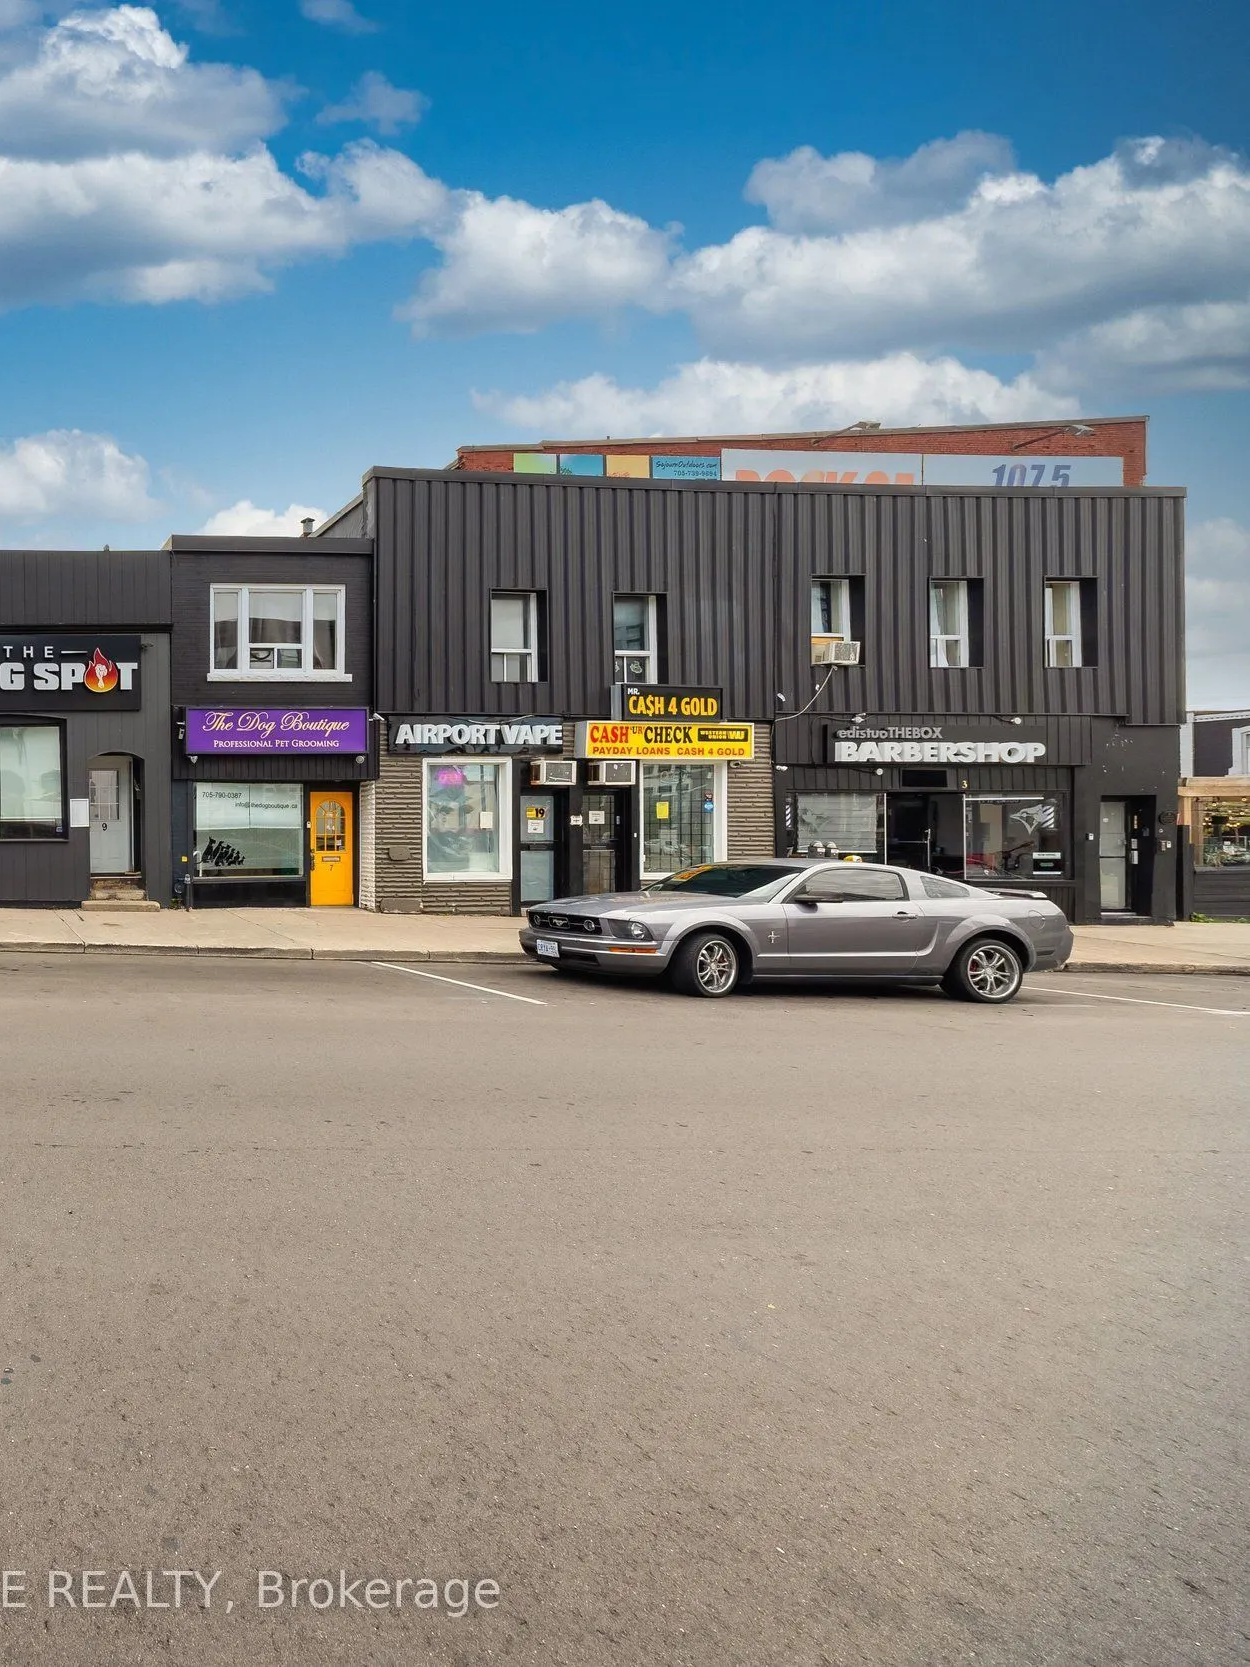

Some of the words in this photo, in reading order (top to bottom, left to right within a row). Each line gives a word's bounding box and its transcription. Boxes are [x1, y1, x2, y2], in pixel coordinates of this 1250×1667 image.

[3, 646, 54, 658] THE
[627, 687, 640, 695] MR.
[628, 695, 665, 716] CA$H
[668, 697, 677, 715] 4
[680, 697, 718, 716] GOLD
[202, 711, 234, 731] The
[236, 711, 276, 738] Dog
[280, 711, 350, 737] Boutique
[395, 724, 500, 744] AIRPORT
[500, 724, 563, 745] VAPE
[590, 725, 629, 743] CASH
[644, 726, 693, 744] CHECK
[592, 747, 633, 755] PAYDAY
[636, 747, 670, 755] LOANS
[677, 747, 705, 756] CASH
[717, 748, 745, 756] GOLD
[835, 742, 1046, 763] BARBERSHOP
[962, 780, 968, 788] 3
[534, 807, 545, 818] 19
[101, 822, 108, 831] 9
